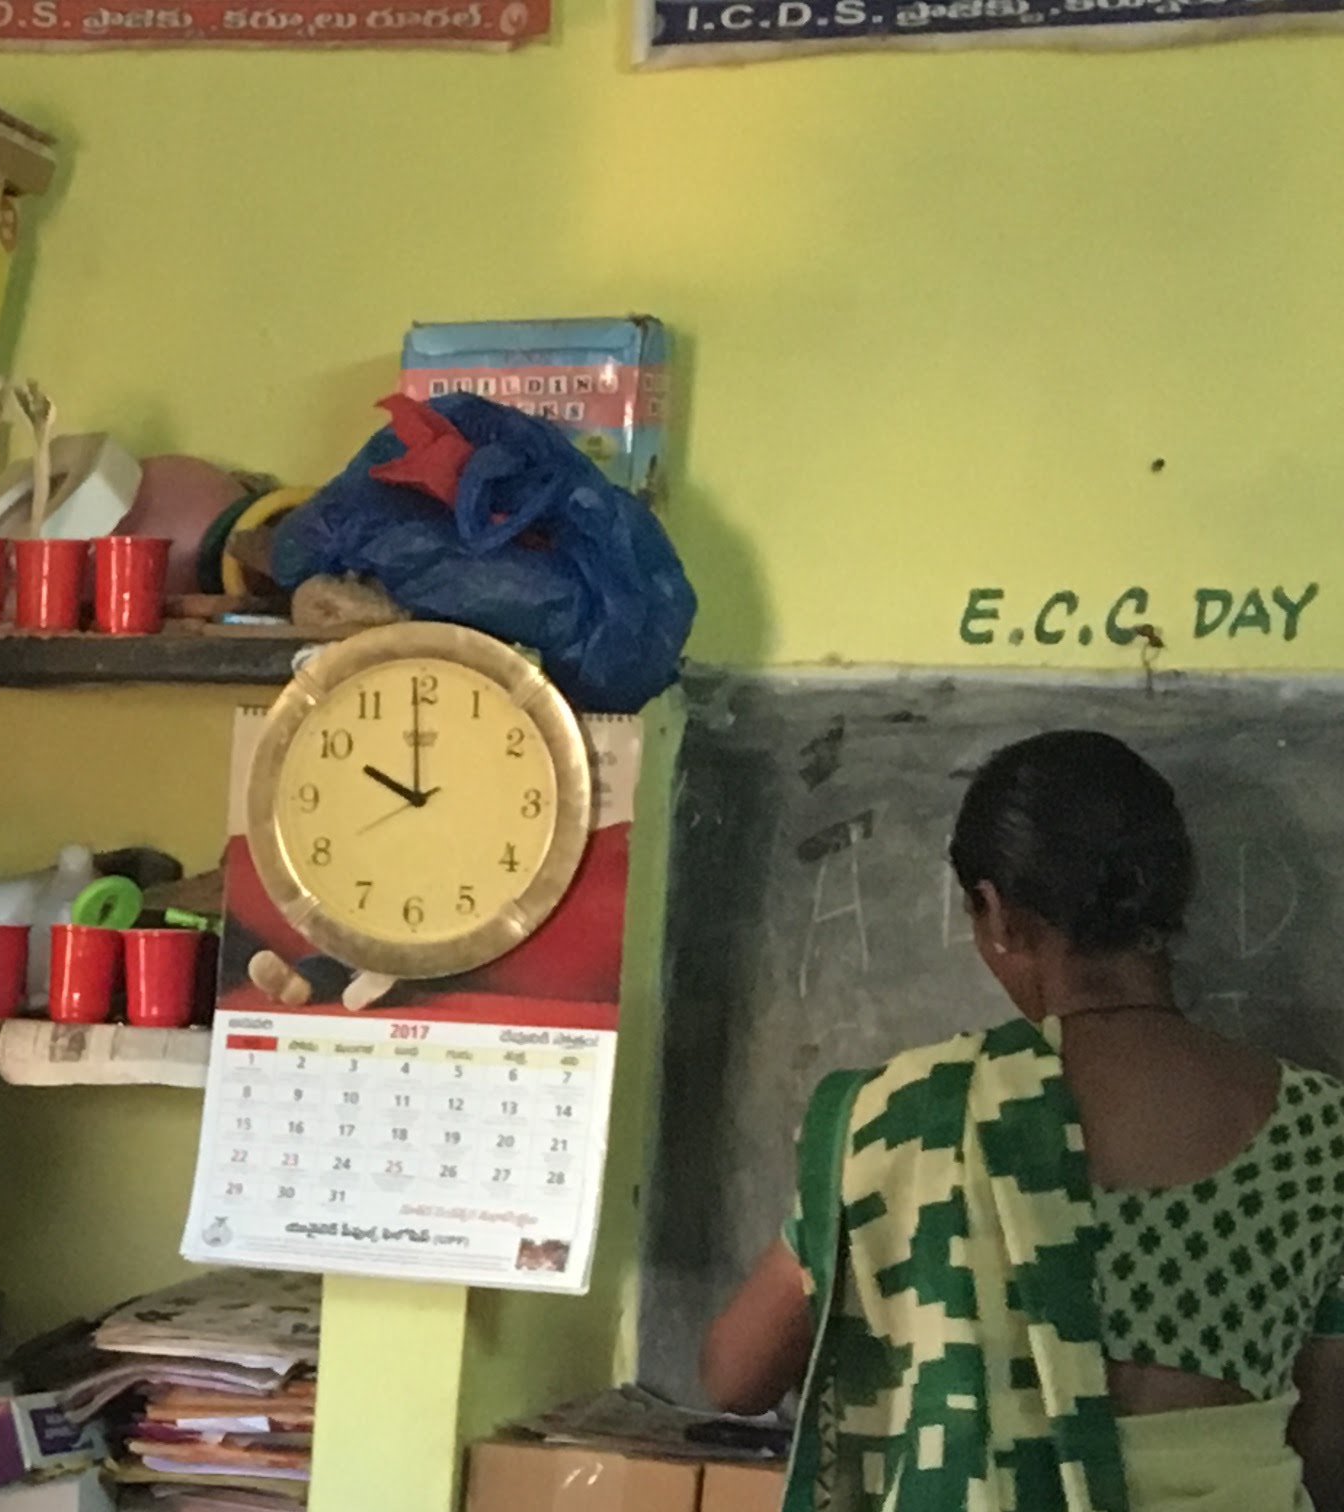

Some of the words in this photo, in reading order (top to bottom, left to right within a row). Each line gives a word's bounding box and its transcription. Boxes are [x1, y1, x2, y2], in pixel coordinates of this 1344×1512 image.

[687, 0, 883, 31] I.C.D.S.
[1193, 582, 1319, 642] DAY
[357, 690, 382, 720] 11
[470, 690, 481, 719] 1
[320, 729, 354, 760] 10
[505, 728, 526, 758] 2
[298, 783, 320, 814] 9
[520, 789, 542, 819] 3
[311, 836, 332, 867] 8
[498, 841, 520, 873] 4
[355, 880, 374, 910] 7
[455, 885, 476, 915] 5
[402, 896, 425, 927] 6
[389, 1023, 430, 1040] 2017
[248, 1052, 255, 1066] 1
[297, 1055, 306, 1070] 2
[349, 1058, 358, 1072] 3
[400, 1061, 410, 1075] 4
[454, 1065, 463, 1079] 5
[509, 1068, 518, 1082] 6
[563, 1071, 572, 1084] 7
[242, 1085, 252, 1099] 8
[293, 1088, 303, 1102] 9
[343, 1091, 360, 1105] 10
[395, 1094, 410, 1108] 11
[448, 1098, 464, 1111] 12
[501, 1101, 518, 1115] 13
[555, 1104, 572, 1118] 14
[236, 1117, 252, 1131] 15
[288, 1120, 305, 1135] 16
[339, 1124, 355, 1138] 17
[392, 1127, 408, 1142] 18
[444, 1131, 461, 1145] 19
[497, 1134, 515, 1148] 20
[550, 1137, 567, 1152] 21
[230, 1148, 248, 1163] 22
[281, 1152, 299, 1167] 23
[333, 1156, 351, 1171] 24
[385, 1160, 403, 1174] 25
[439, 1164, 457, 1179] 26
[492, 1168, 511, 1182] 27
[547, 1171, 565, 1186] 28
[225, 1182, 243, 1196] 29
[277, 1185, 295, 1200] 30
[329, 1189, 346, 1203] 31
